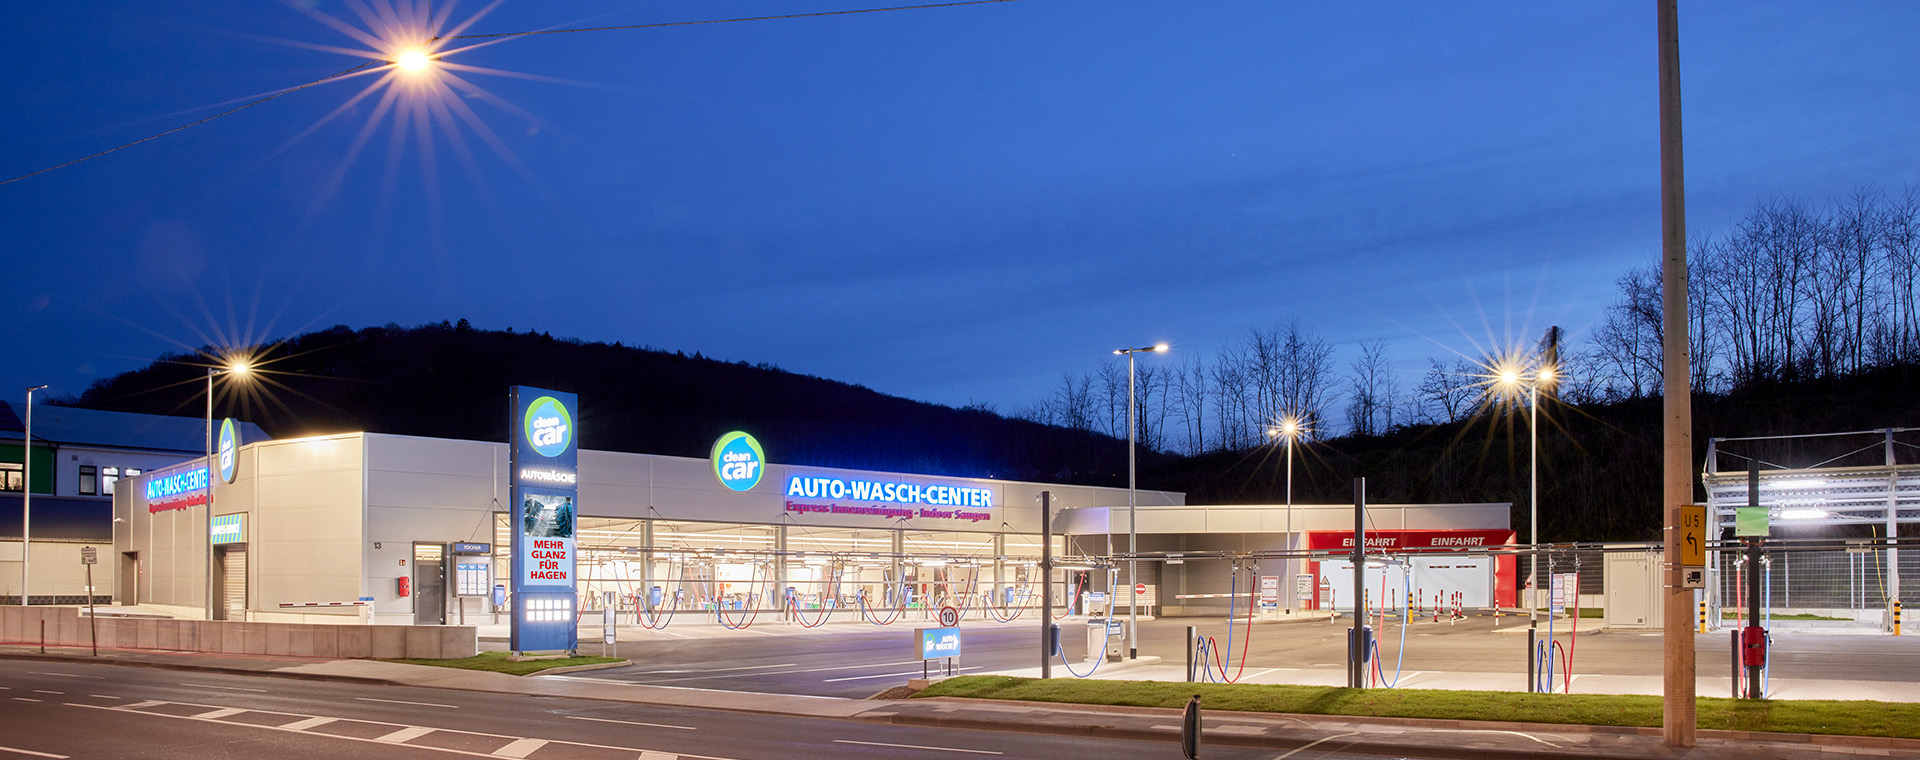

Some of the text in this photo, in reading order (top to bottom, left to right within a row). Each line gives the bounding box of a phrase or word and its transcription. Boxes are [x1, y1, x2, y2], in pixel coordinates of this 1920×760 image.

[533, 416, 560, 429] clean
[533, 425, 567, 447] car
[723, 451, 751, 463] clean
[520, 469, 577, 484] AUTOWÄSCHE
[721, 461, 759, 480] car
[146, 467, 209, 499] AUTO-WASCH-CENTE
[787, 476, 993, 507] AUTO-WASCH-CENTER
[785, 501, 830, 515] Express
[831, 503, 914, 519] Innenreinigung
[919, 508, 954, 519] Indoor
[954, 509, 991, 523] Saugen
[373, 541, 382, 550] 13
[533, 540, 564, 549] MEHR
[1430, 536, 1486, 547] EINFAHRT
[531, 550, 567, 559] GLANZ
[539, 559, 559, 570] FÜR
[530, 571, 567, 579] HAGEN
[943, 611, 954, 623] 10
